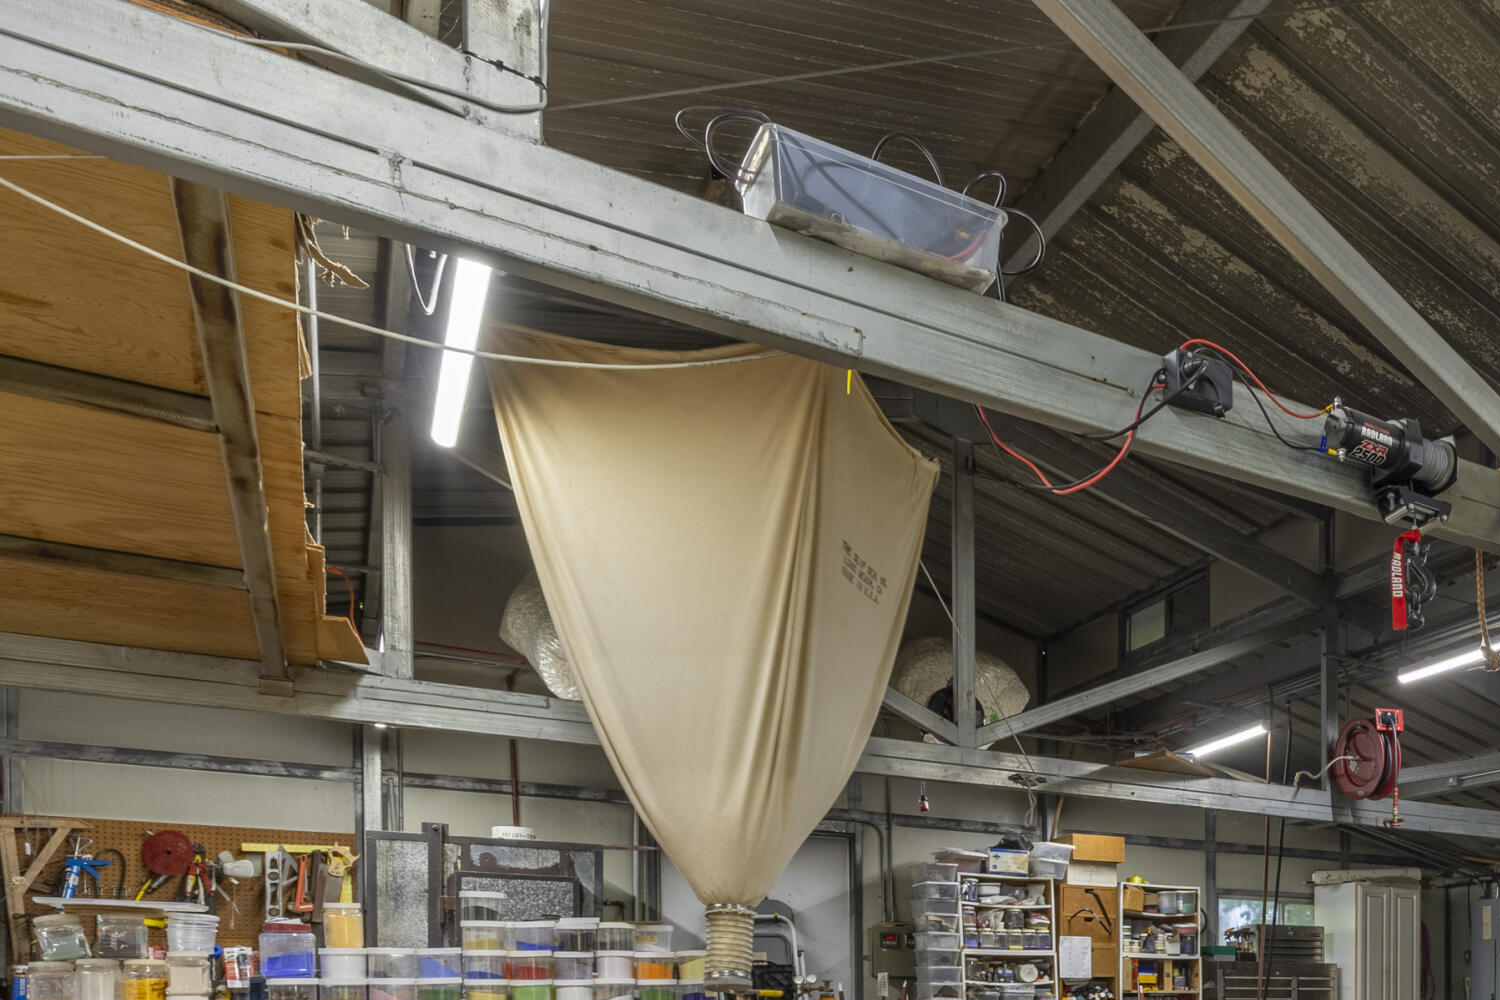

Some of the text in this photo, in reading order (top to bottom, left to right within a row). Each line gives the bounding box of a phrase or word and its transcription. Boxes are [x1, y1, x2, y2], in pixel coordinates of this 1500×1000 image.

[1361, 426, 1393, 447] BADLAND
[1351, 447, 1387, 465] 2500
[1361, 440, 1388, 456] ZXR
[1391, 552, 1404, 598] BADLAND
